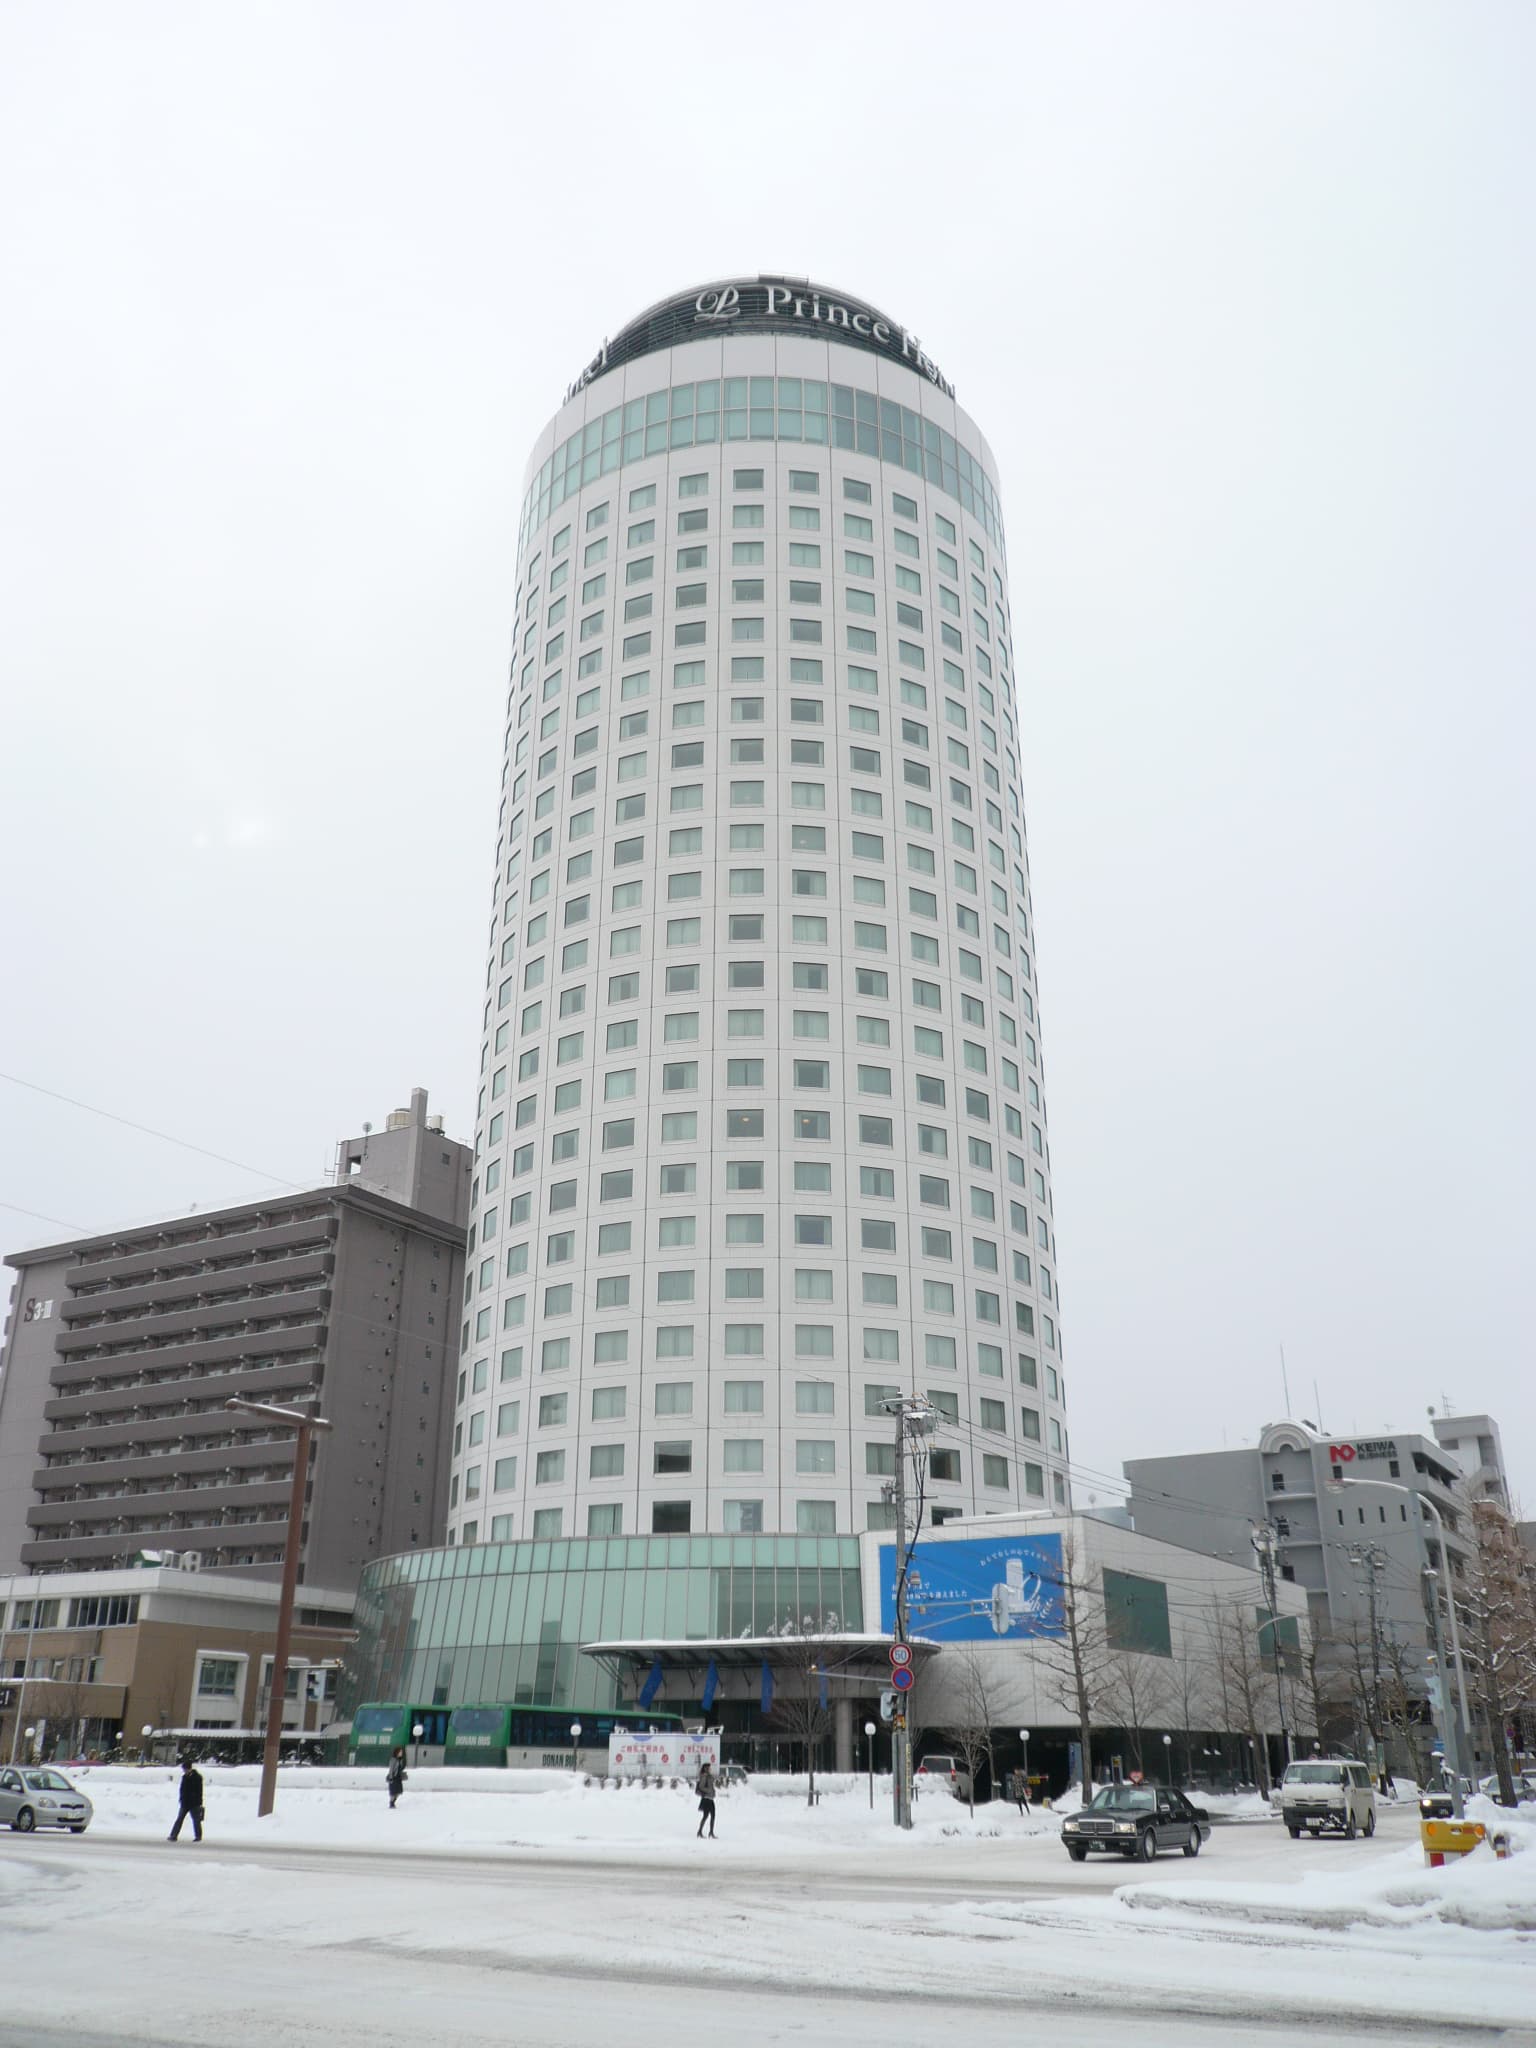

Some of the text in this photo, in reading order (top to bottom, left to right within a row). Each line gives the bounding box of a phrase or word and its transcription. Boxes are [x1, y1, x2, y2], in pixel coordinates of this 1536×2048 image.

[764, 284, 891, 344] Prince
[1357, 1440, 1396, 1452] KEIWA
[455, 1736, 491, 1746] DONAN BUS
[542, 1754, 564, 1767] DONAN
